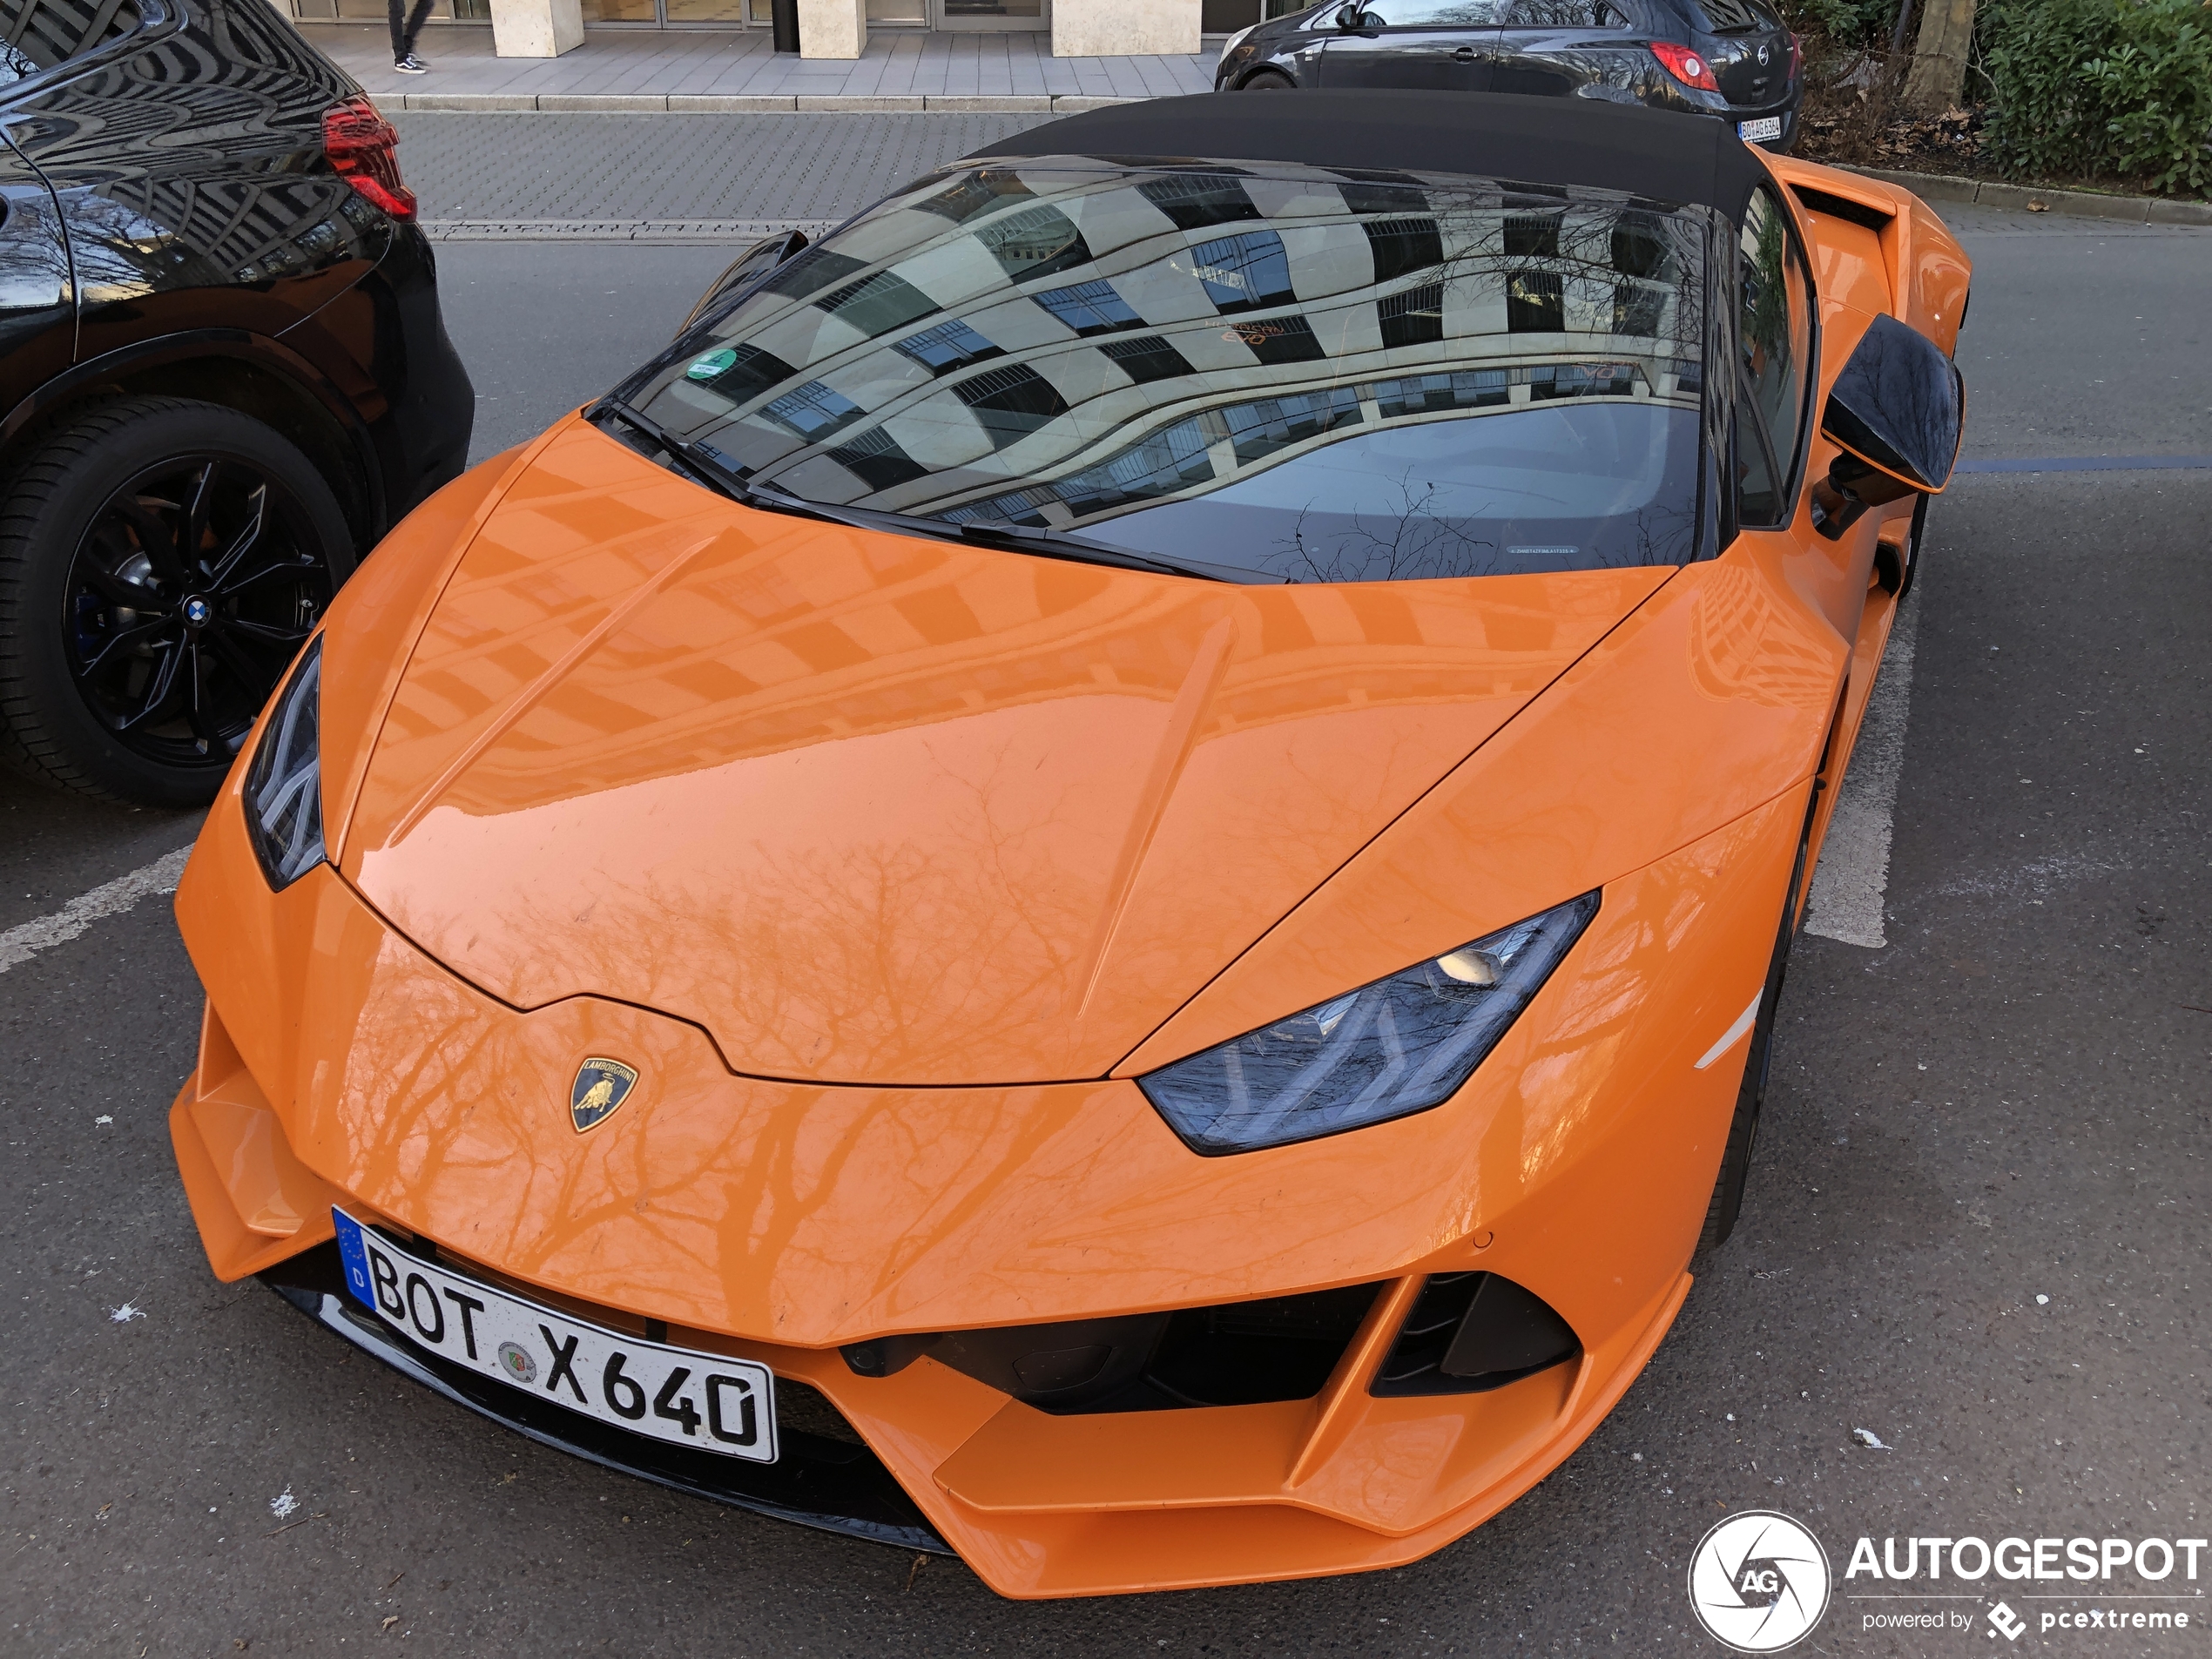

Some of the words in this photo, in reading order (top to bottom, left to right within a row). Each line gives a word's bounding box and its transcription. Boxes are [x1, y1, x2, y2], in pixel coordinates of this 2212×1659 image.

[1743, 124, 1751, 138] BO
[1756, 121, 1764, 137] AG
[1764, 119, 1779, 135] 6364
[1221, 331, 1266, 345] EVO
[584, 1061, 633, 1082] LAMBORGHINI
[353, 1267, 364, 1287] D
[368, 1243, 484, 1361] BOT
[538, 1323, 589, 1404] X
[603, 1352, 757, 1447] 640
